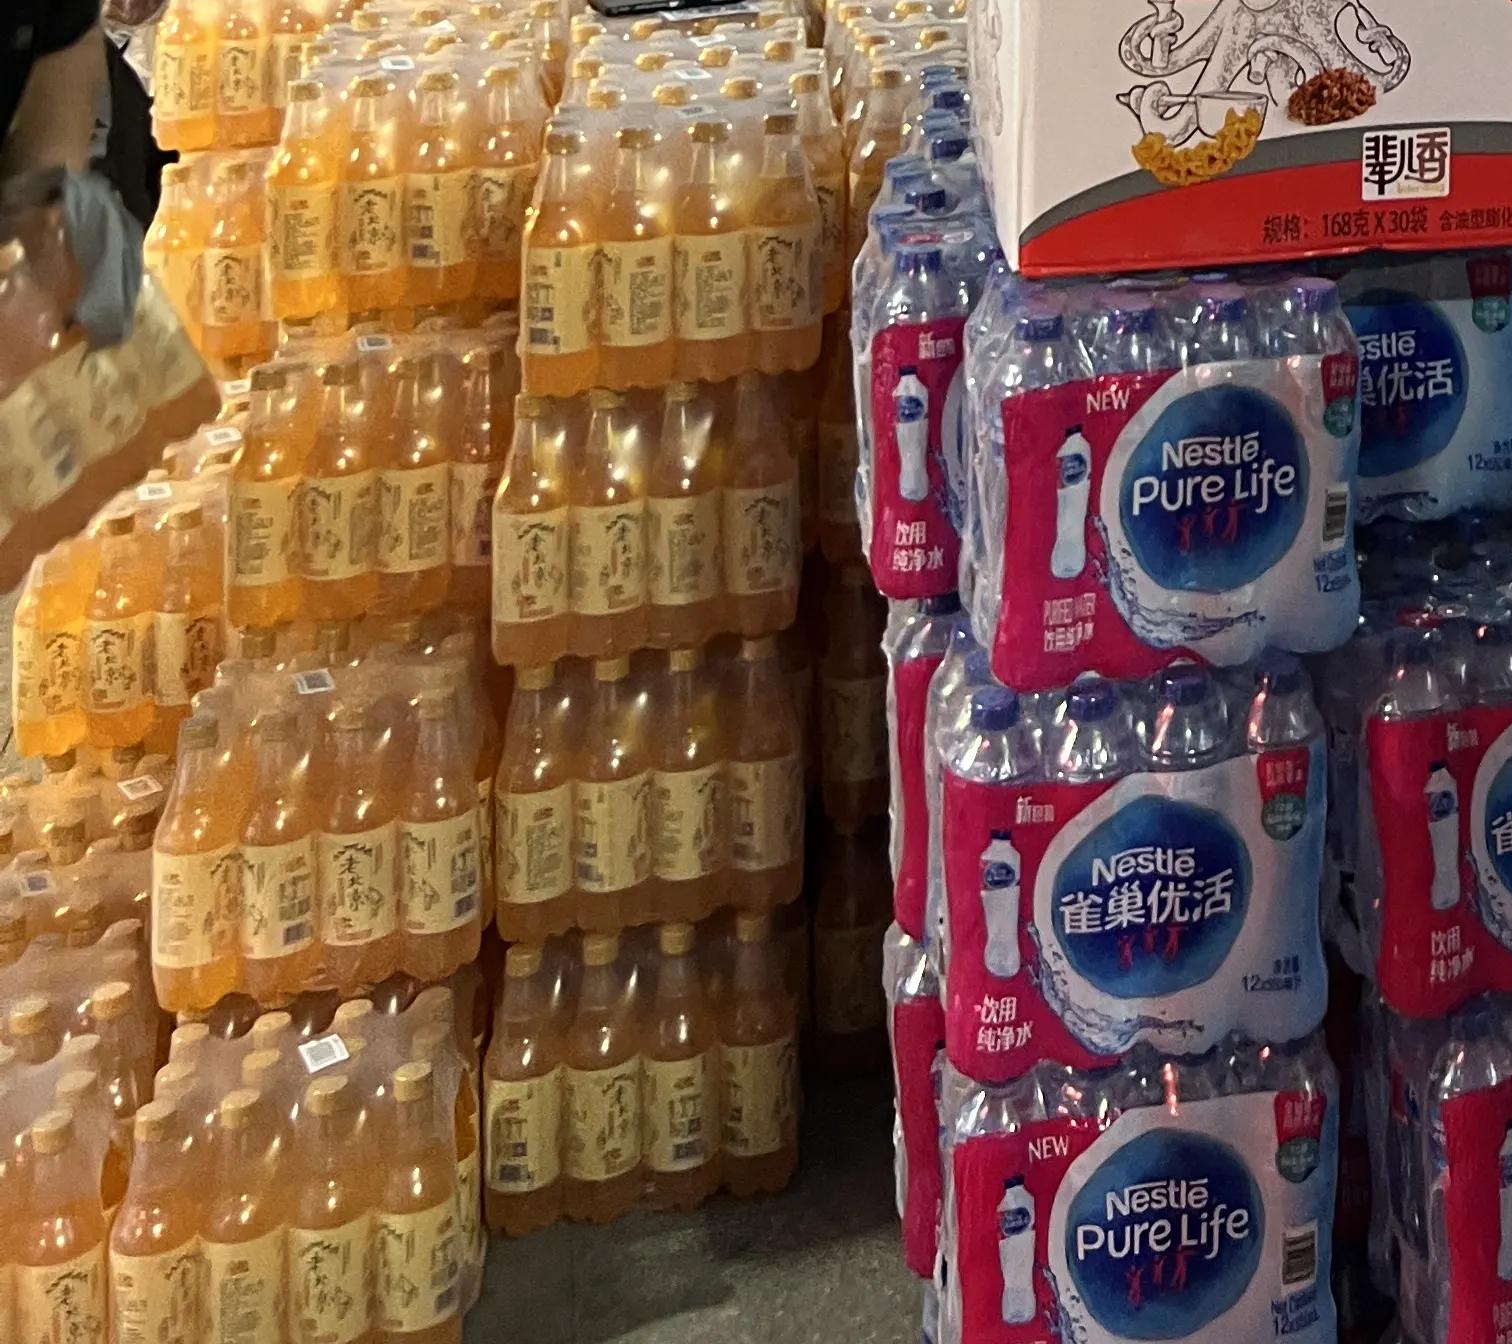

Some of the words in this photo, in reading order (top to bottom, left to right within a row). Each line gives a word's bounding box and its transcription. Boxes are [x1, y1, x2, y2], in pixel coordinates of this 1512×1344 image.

[1360, 330, 1416, 360] stlé
[1085, 389, 1130, 414] NEW
[1161, 432, 1260, 472] Nestlé
[1132, 470, 1224, 516] Pure
[1232, 458, 1297, 515] Life
[895, 519, 927, 545] 饮用
[892, 545, 944, 572] 纯净水
[1092, 846, 1196, 886] Nestlé
[1059, 868, 1234, 935] 雀巢优活
[978, 994, 1018, 1023] 饮用
[976, 1020, 1033, 1053] 纯净水
[1028, 1135, 1070, 1162] NEW
[1105, 1177, 1209, 1221] Nestlé
[1077, 1219, 1171, 1260] Pure
[1180, 1203, 1250, 1260] Life
